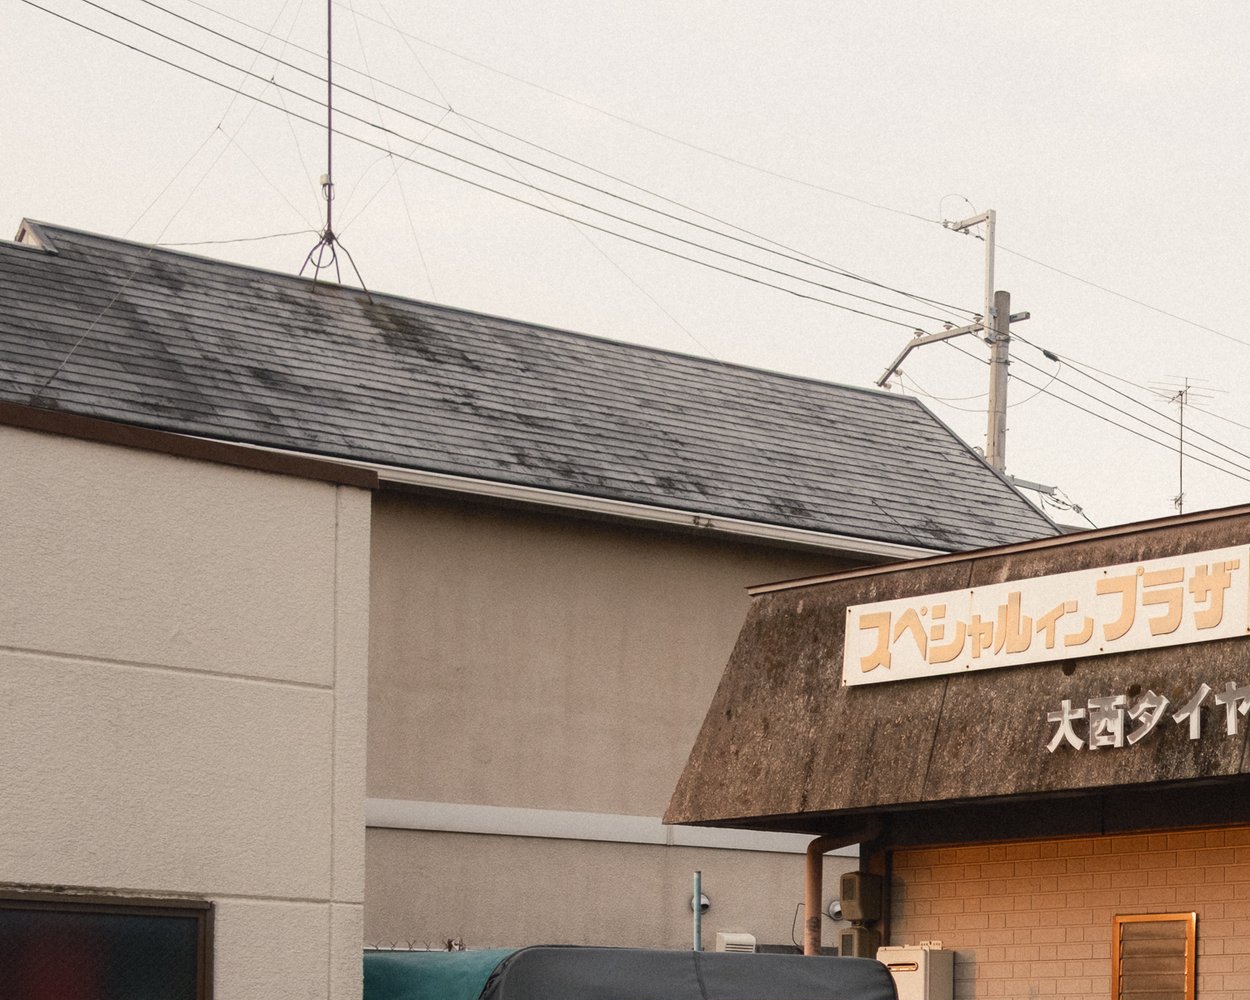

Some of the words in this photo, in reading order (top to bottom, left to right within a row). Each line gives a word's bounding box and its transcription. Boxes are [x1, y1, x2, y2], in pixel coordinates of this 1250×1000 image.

[859, 560, 1240, 673] スペシャルインプラザ
